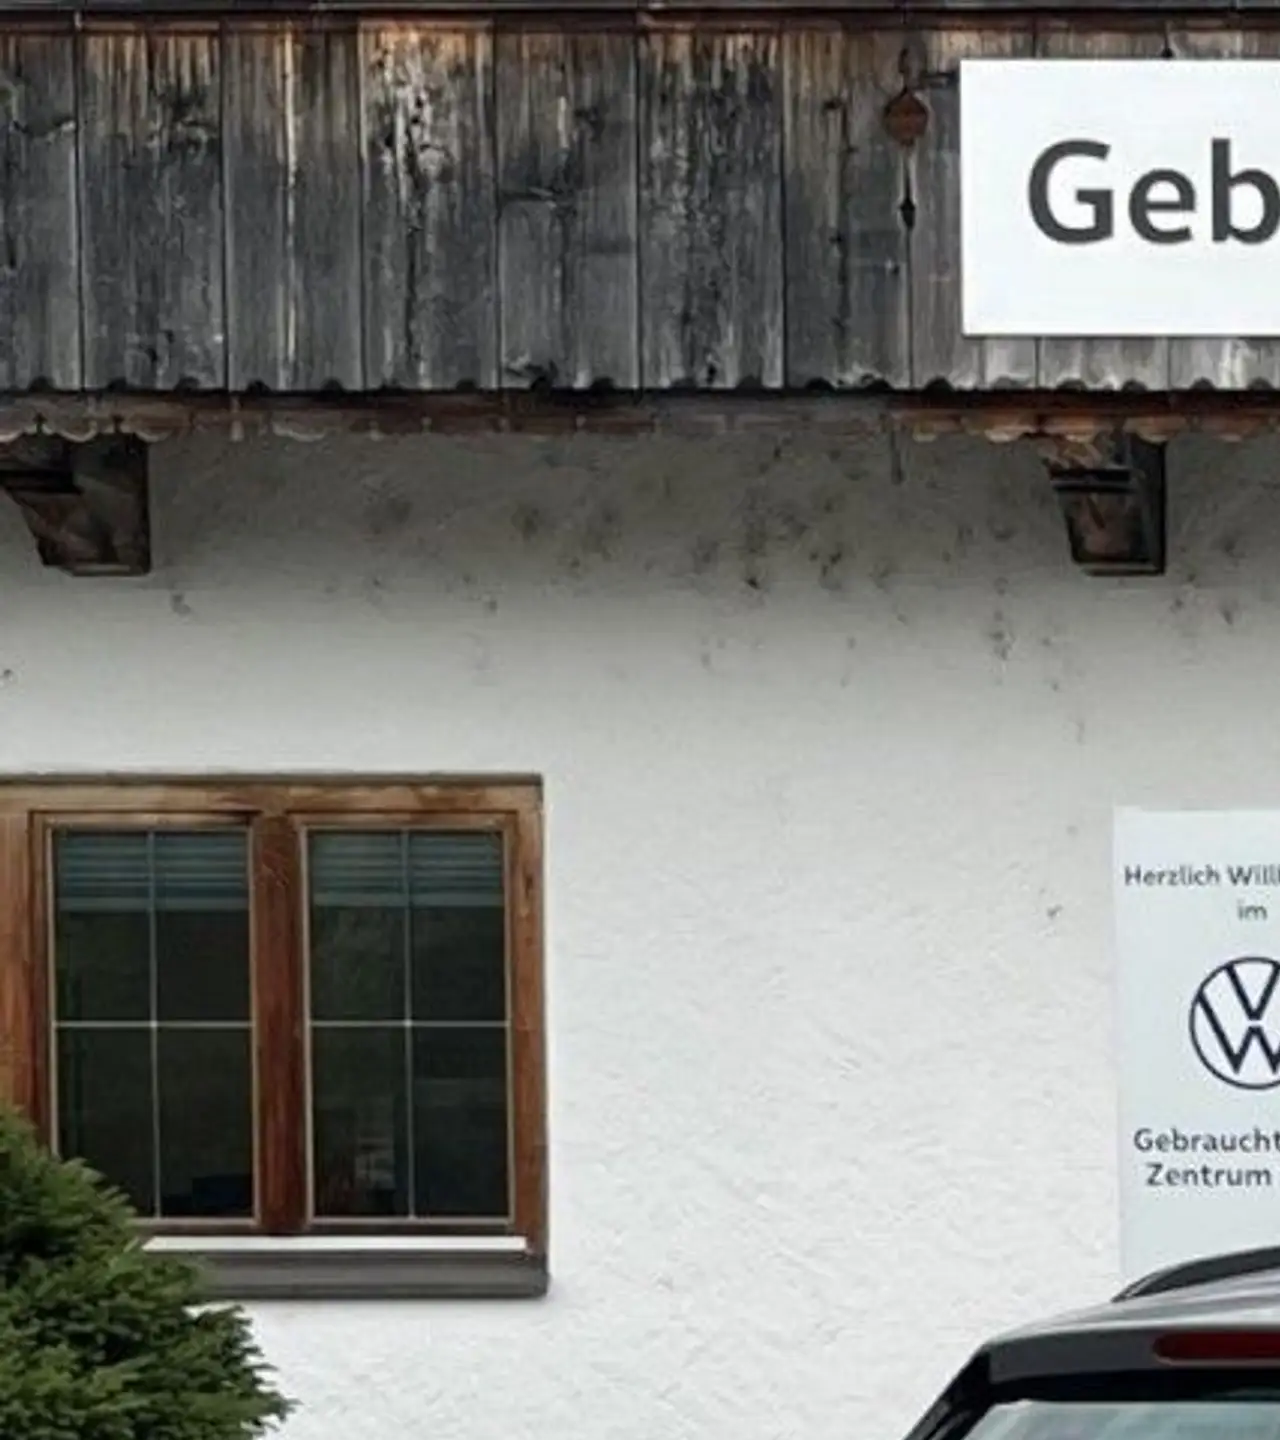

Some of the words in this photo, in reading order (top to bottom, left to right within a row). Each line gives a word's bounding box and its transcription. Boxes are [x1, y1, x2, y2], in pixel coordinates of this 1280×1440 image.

[1124, 864, 1221, 887] Herzlich
[1237, 902, 1268, 921] im
[1146, 1162, 1272, 1188] Zentrum
